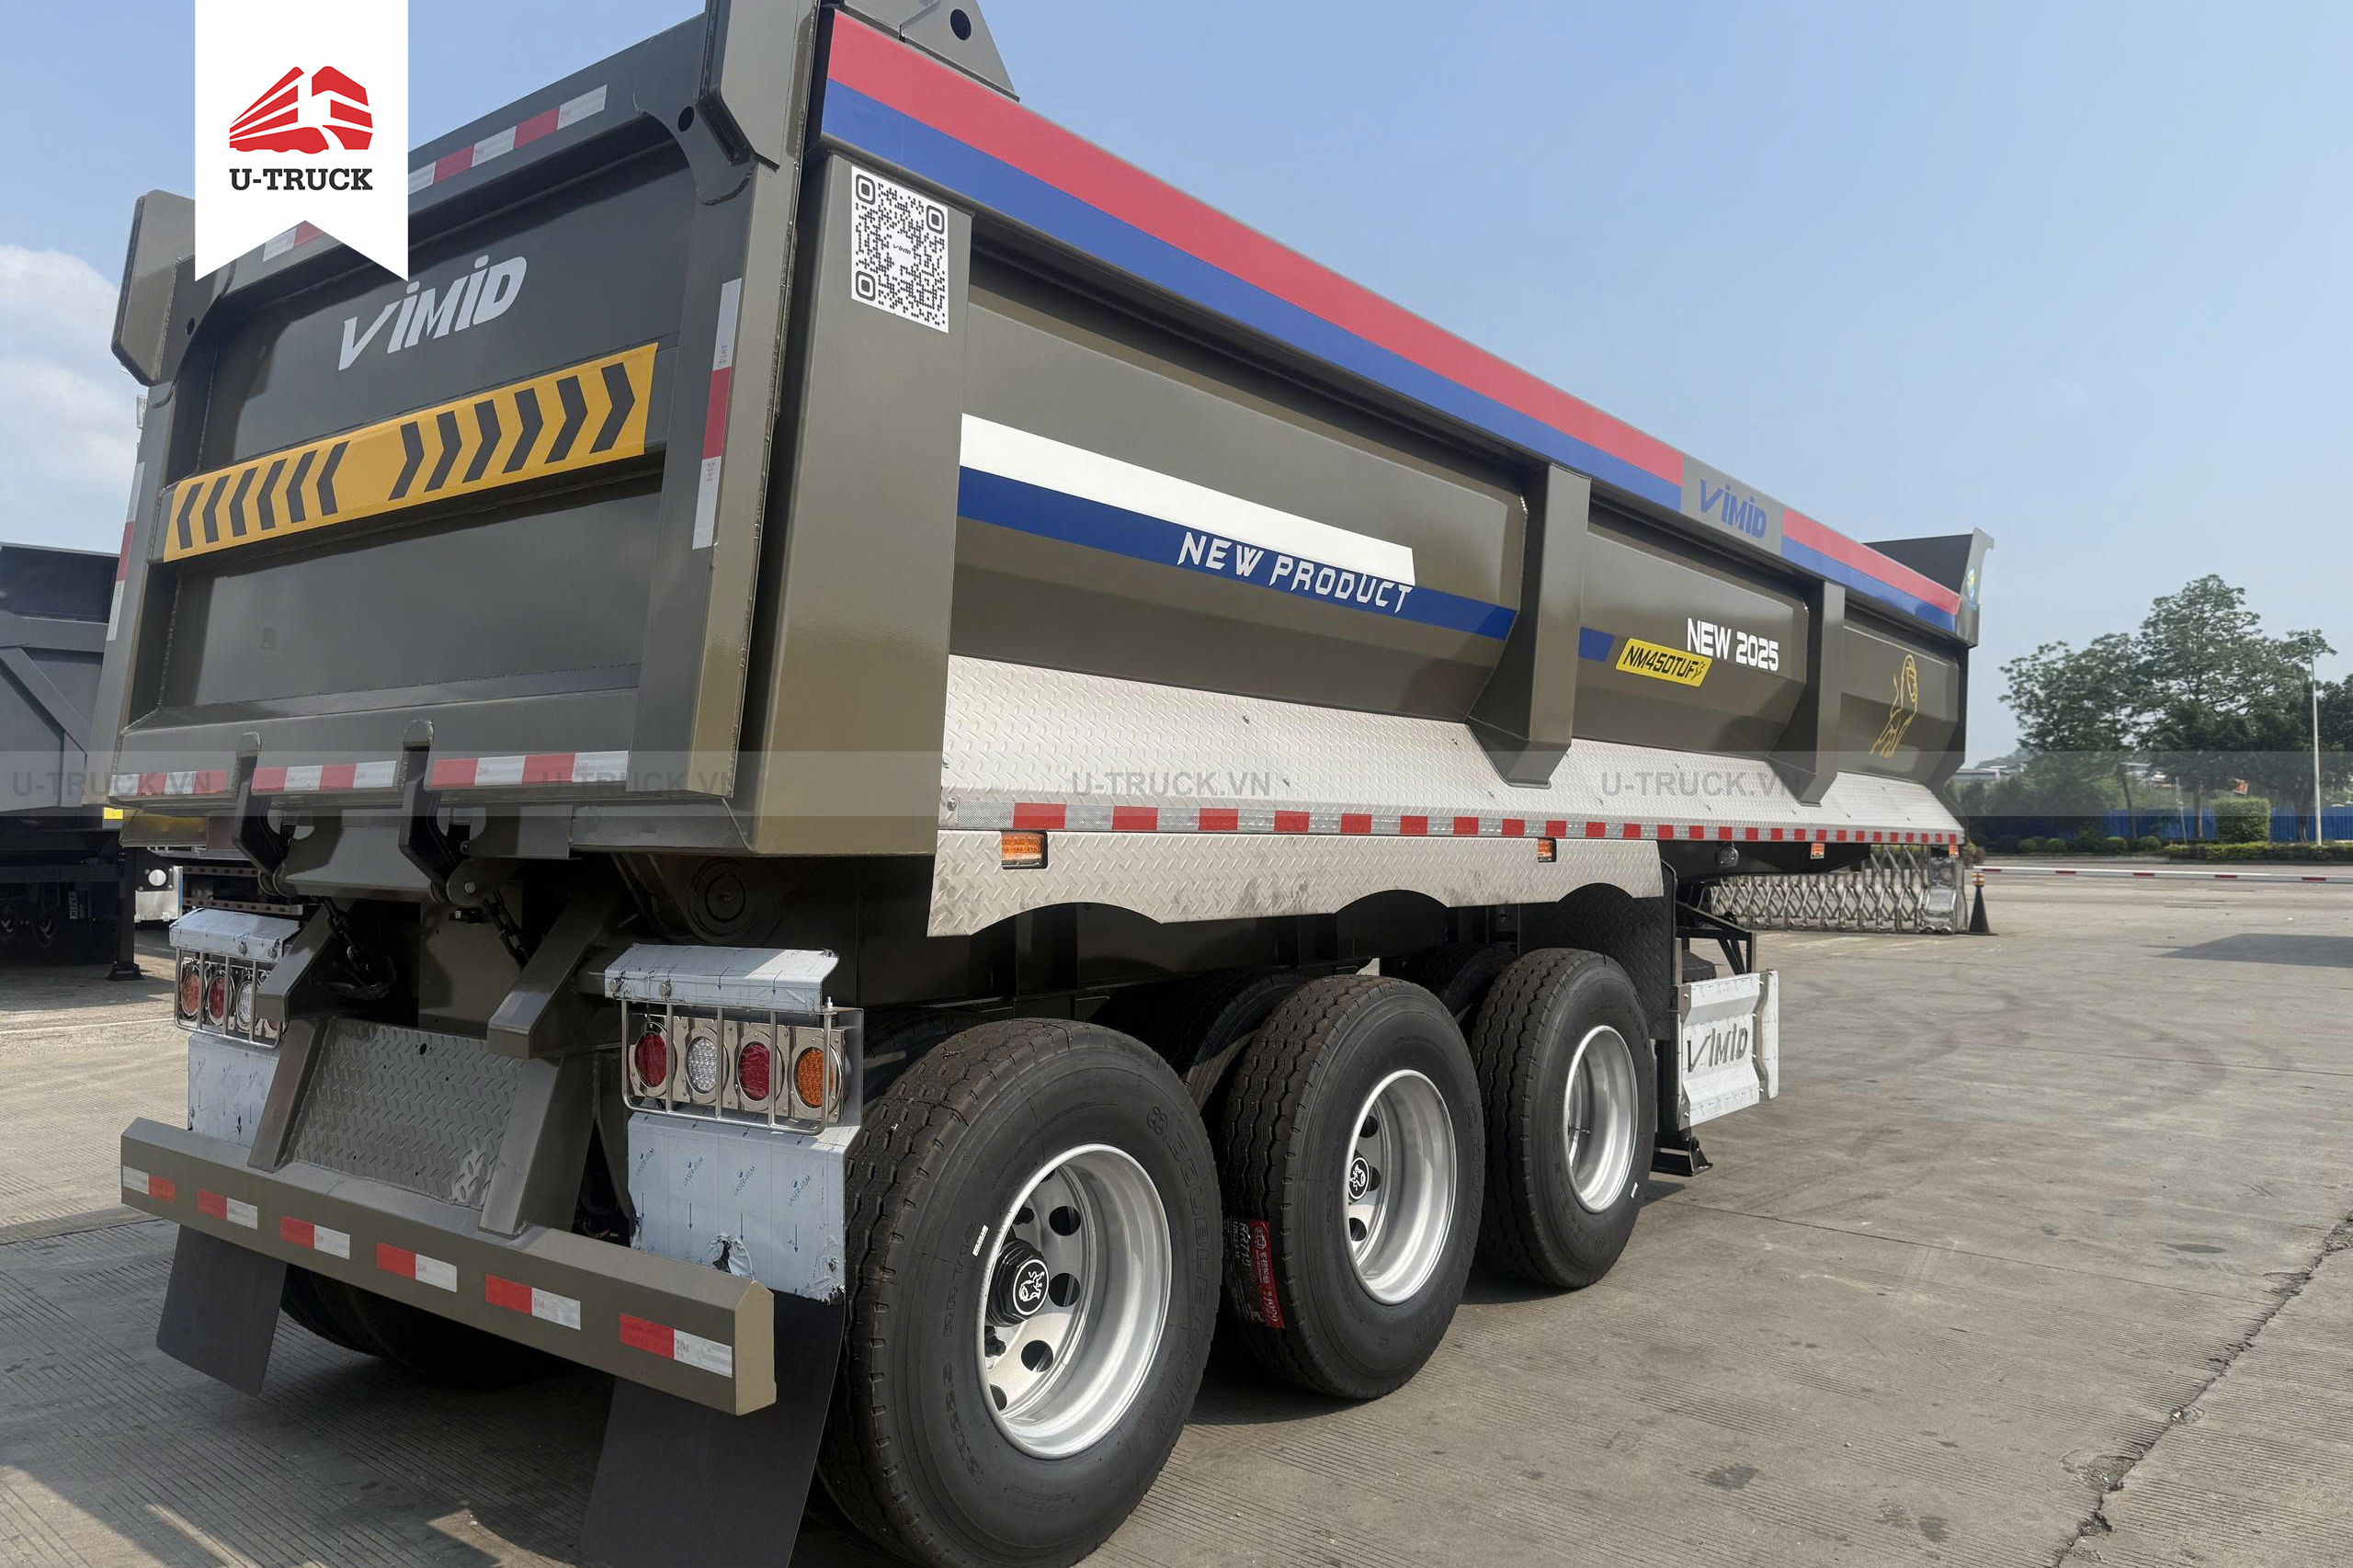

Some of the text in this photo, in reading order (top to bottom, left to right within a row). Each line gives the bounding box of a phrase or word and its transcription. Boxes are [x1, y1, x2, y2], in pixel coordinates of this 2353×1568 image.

[1176, 531, 1414, 614] NEW PRODUCT
[1687, 617, 1779, 672] NEW 2025
